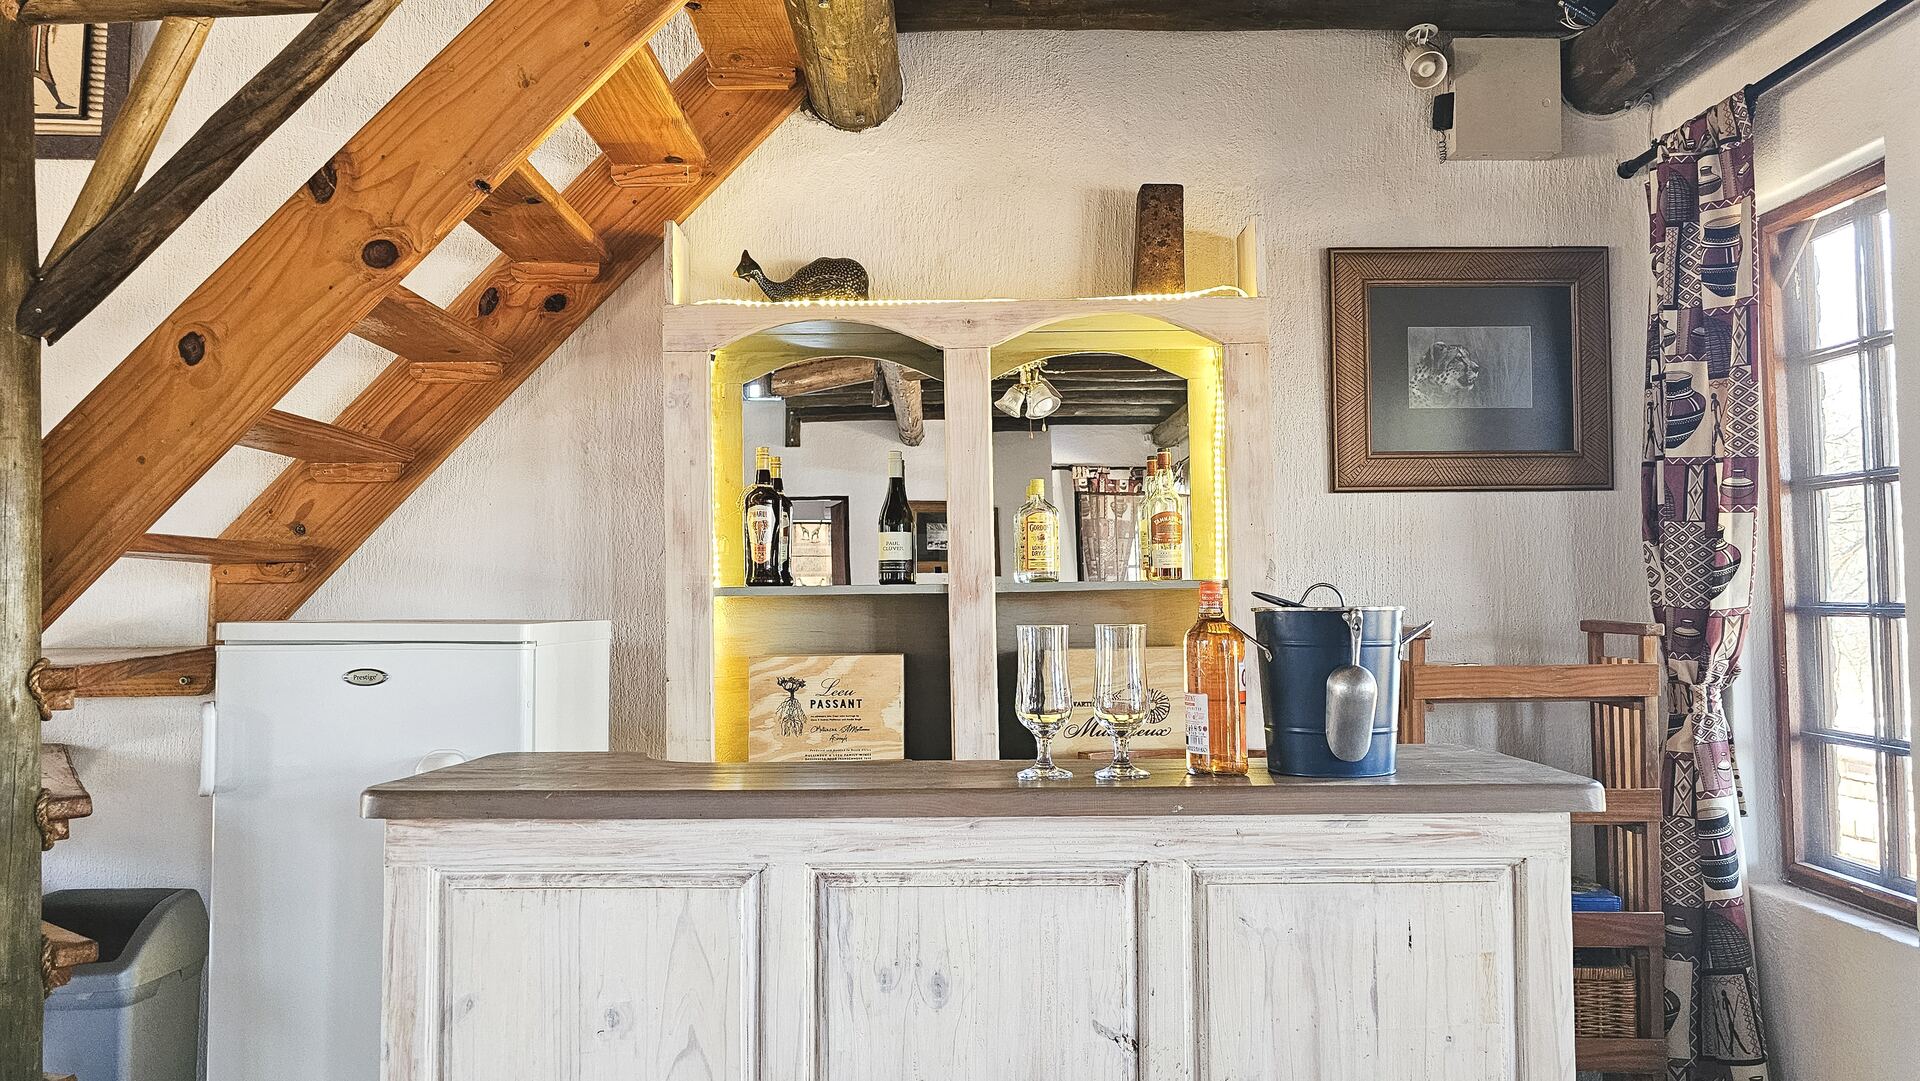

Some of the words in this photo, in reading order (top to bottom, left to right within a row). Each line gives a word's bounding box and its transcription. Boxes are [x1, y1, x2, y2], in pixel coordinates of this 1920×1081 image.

[353, 673, 377, 682] Prestige
[815, 677, 857, 697] Leeu
[810, 698, 863, 710] PASSANT
